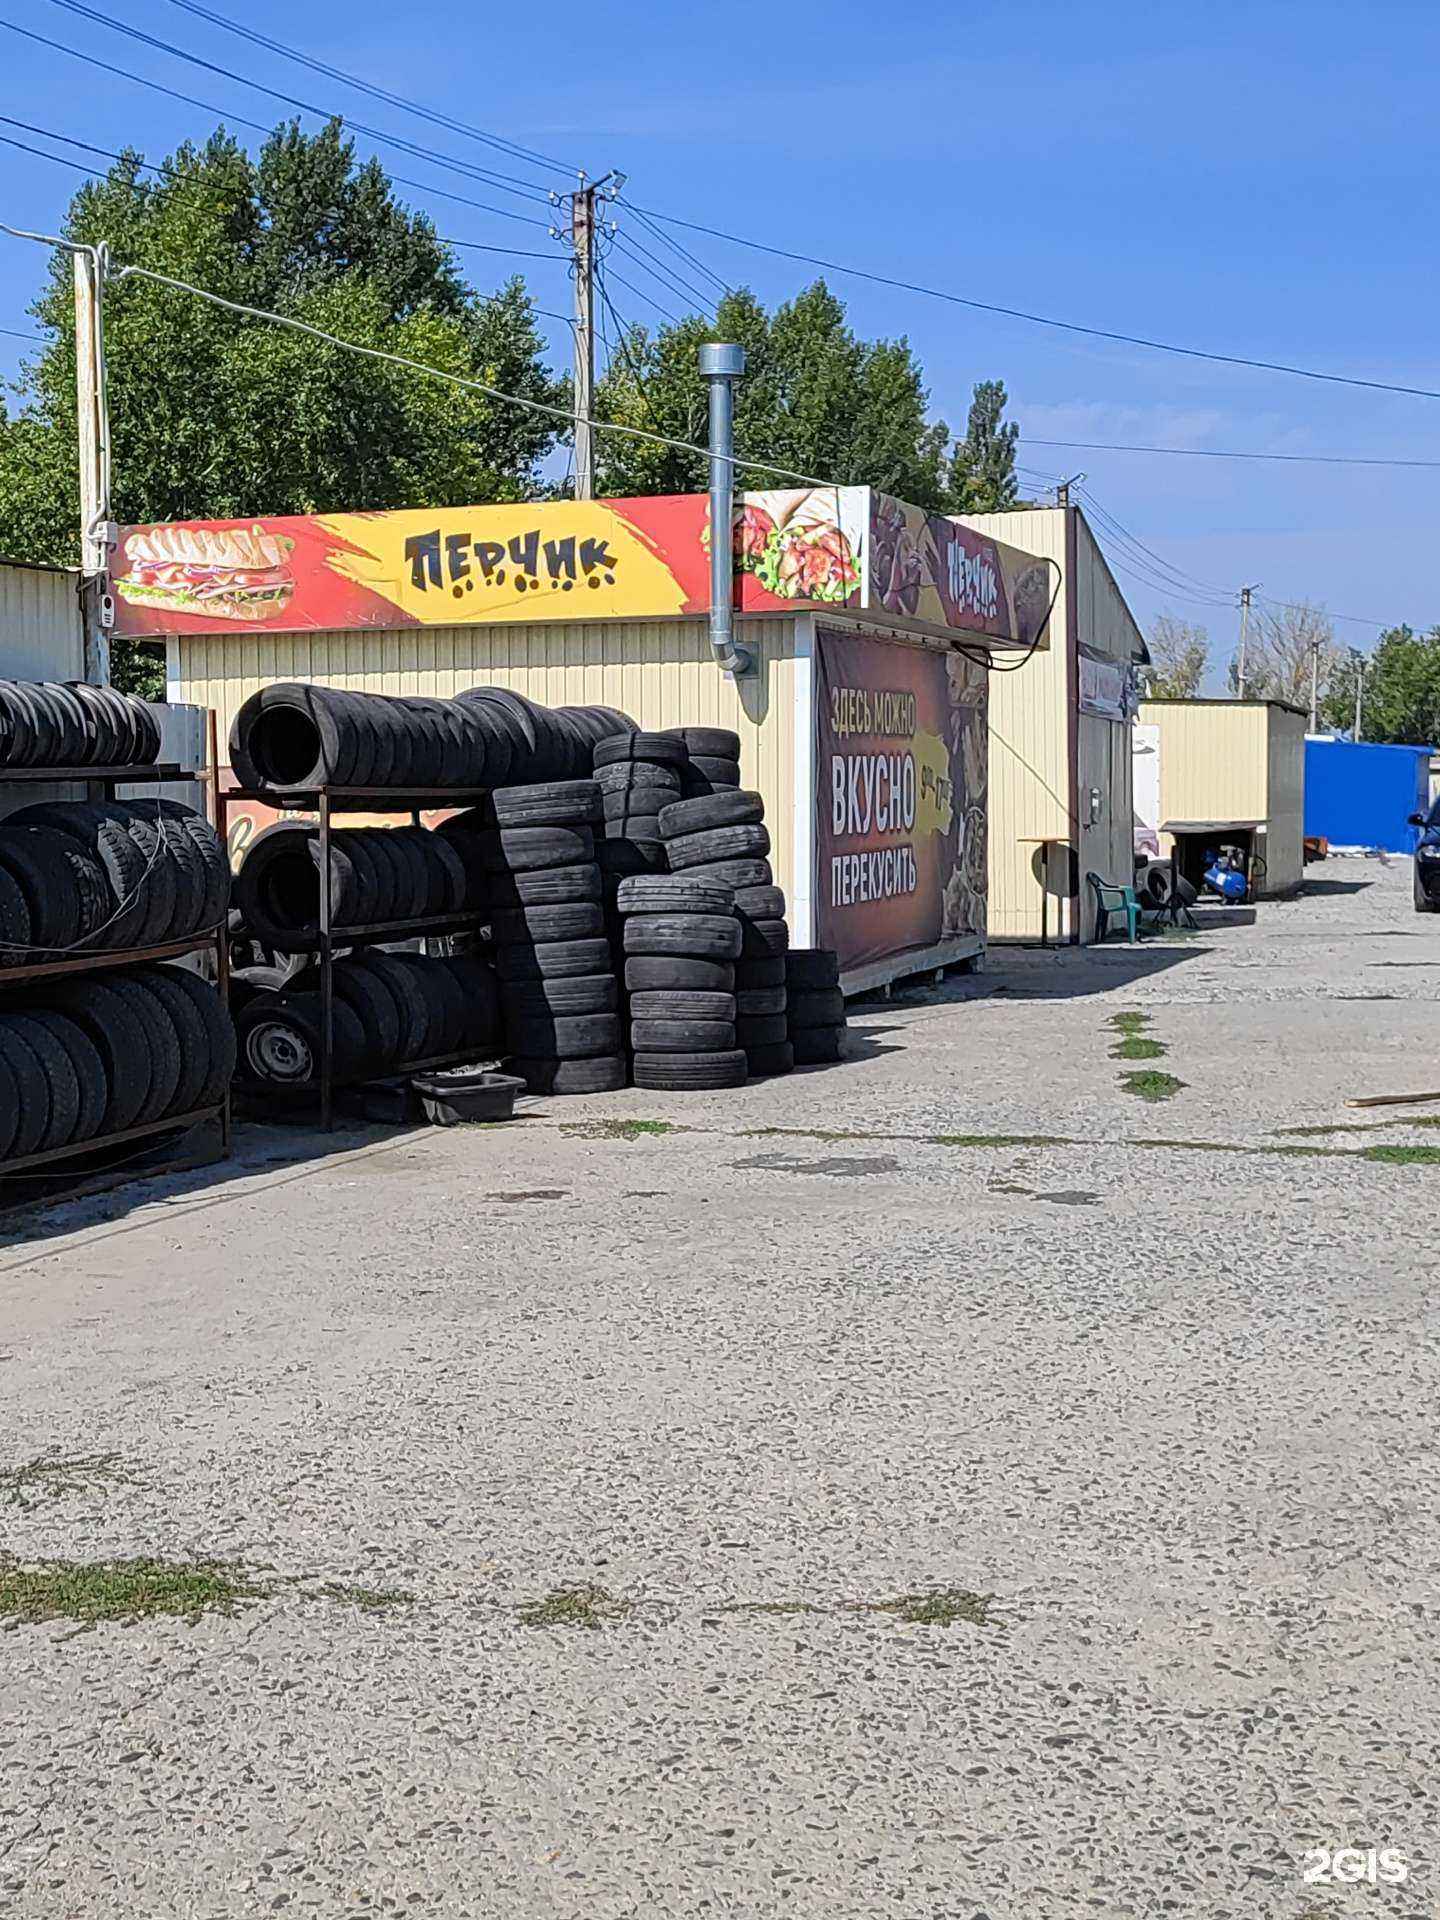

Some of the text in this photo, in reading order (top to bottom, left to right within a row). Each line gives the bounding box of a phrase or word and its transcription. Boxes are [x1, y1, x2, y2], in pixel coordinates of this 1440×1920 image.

[404, 528, 619, 598] ПЕРЧИК
[946, 539, 999, 613] ПЕРЧИК
[831, 686, 916, 739] ЗДЕСЬ МОЖНО
[832, 754, 915, 836] ВКУСНО
[831, 848, 917, 907] ПЕРЕКУСИТЬ
